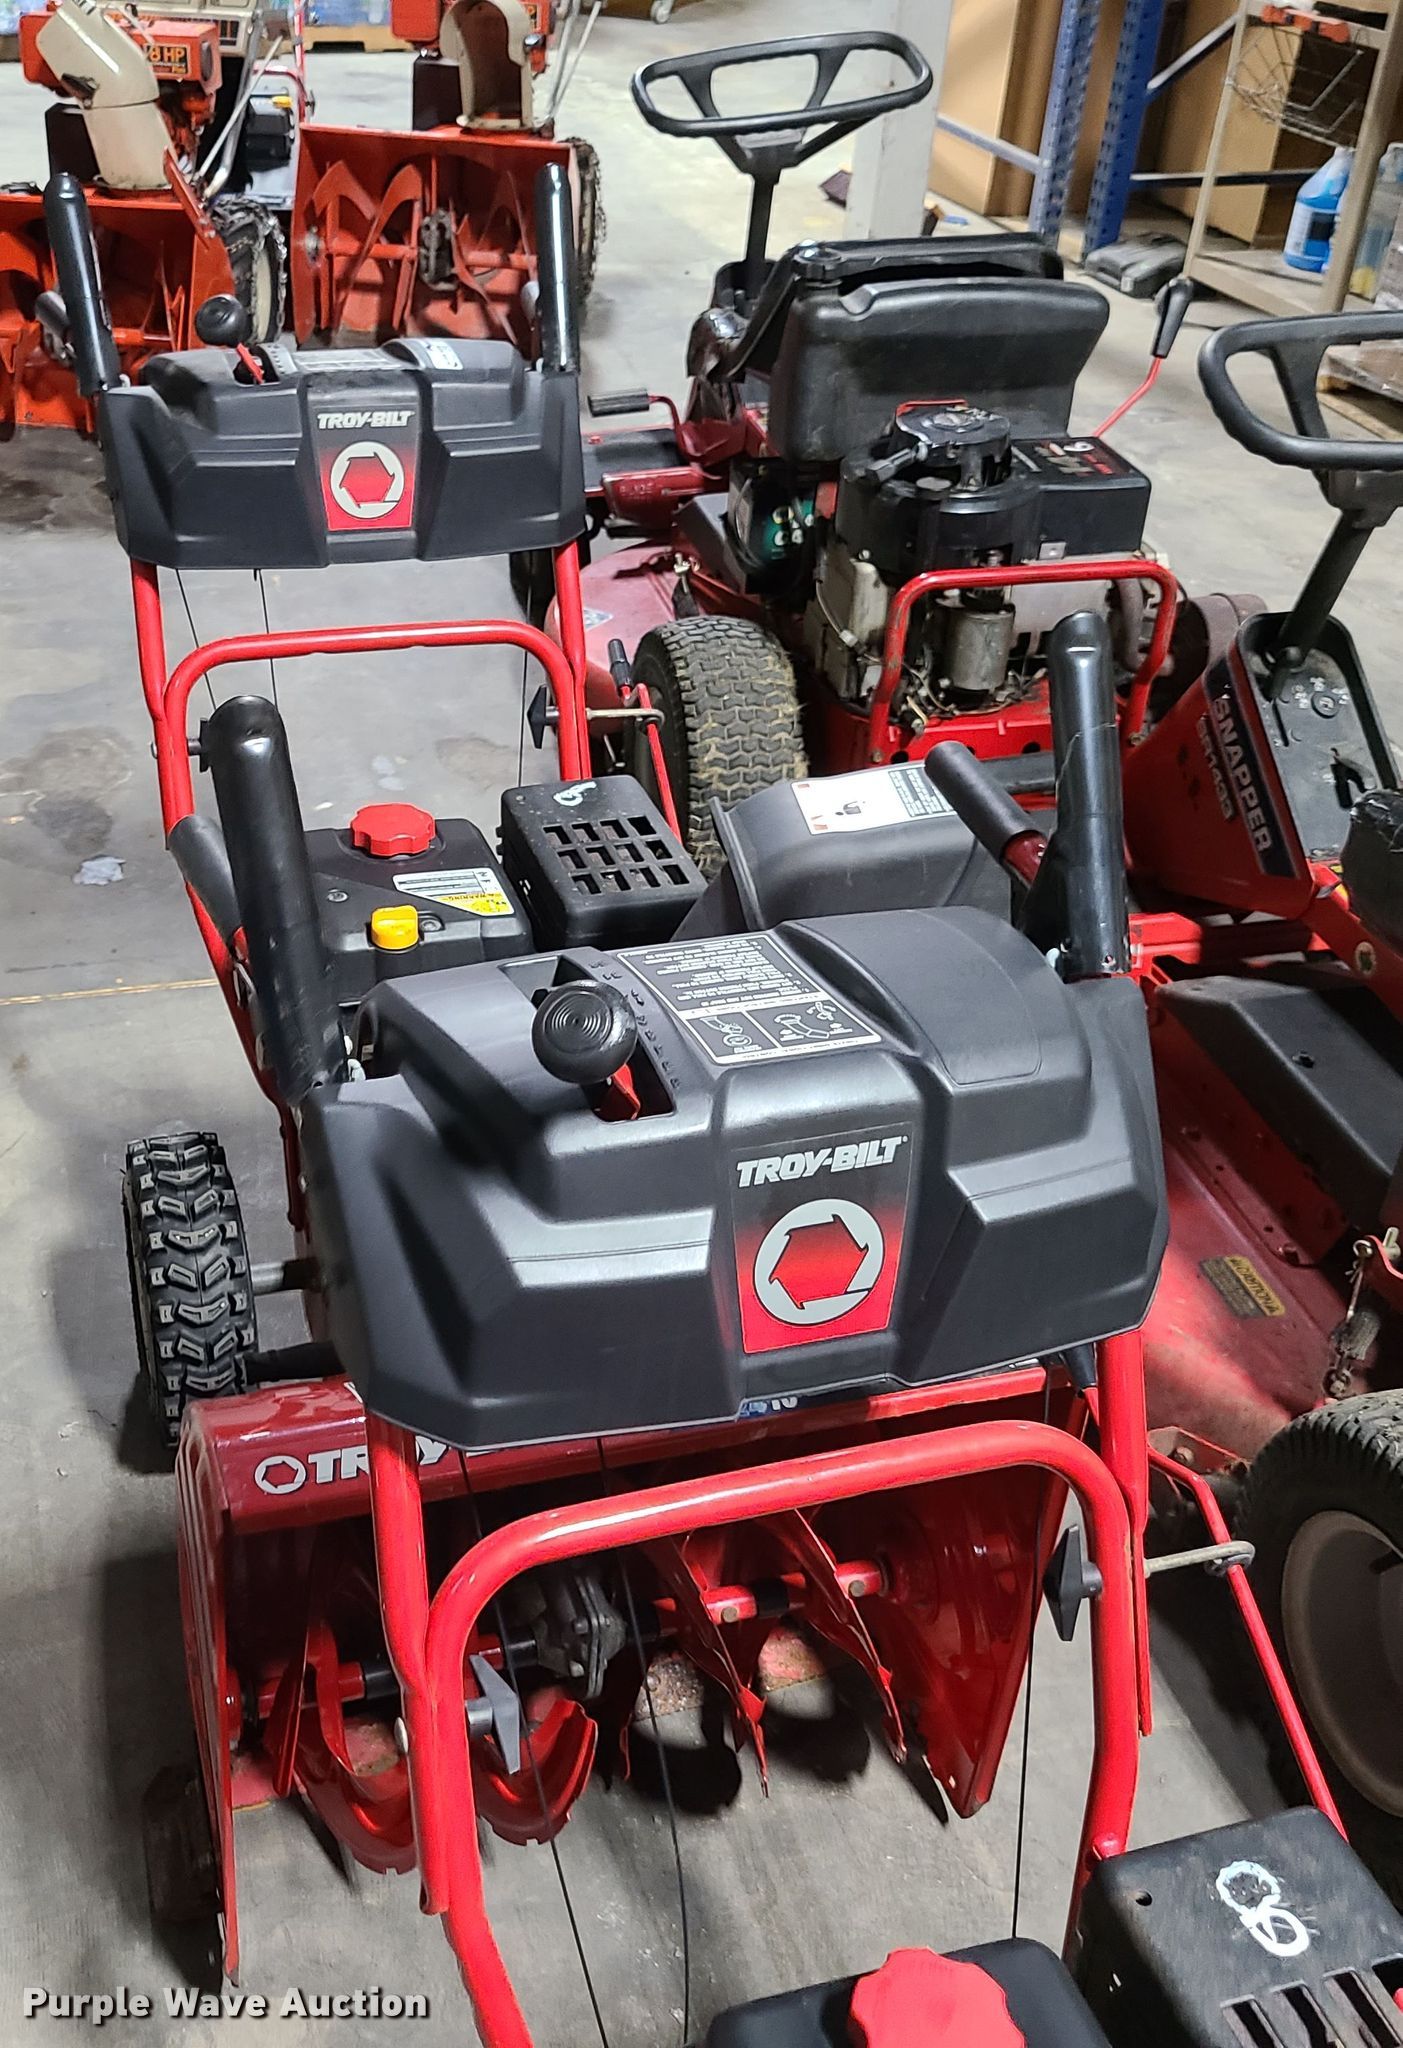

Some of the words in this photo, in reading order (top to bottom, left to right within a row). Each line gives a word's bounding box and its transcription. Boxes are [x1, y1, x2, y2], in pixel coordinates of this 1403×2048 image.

[163, 48, 186, 62] HP
[317, 411, 413, 430] TROY-BILT
[1212, 698, 1274, 853] SNAPPER
[736, 1135, 907, 1189] TROY-BILT
